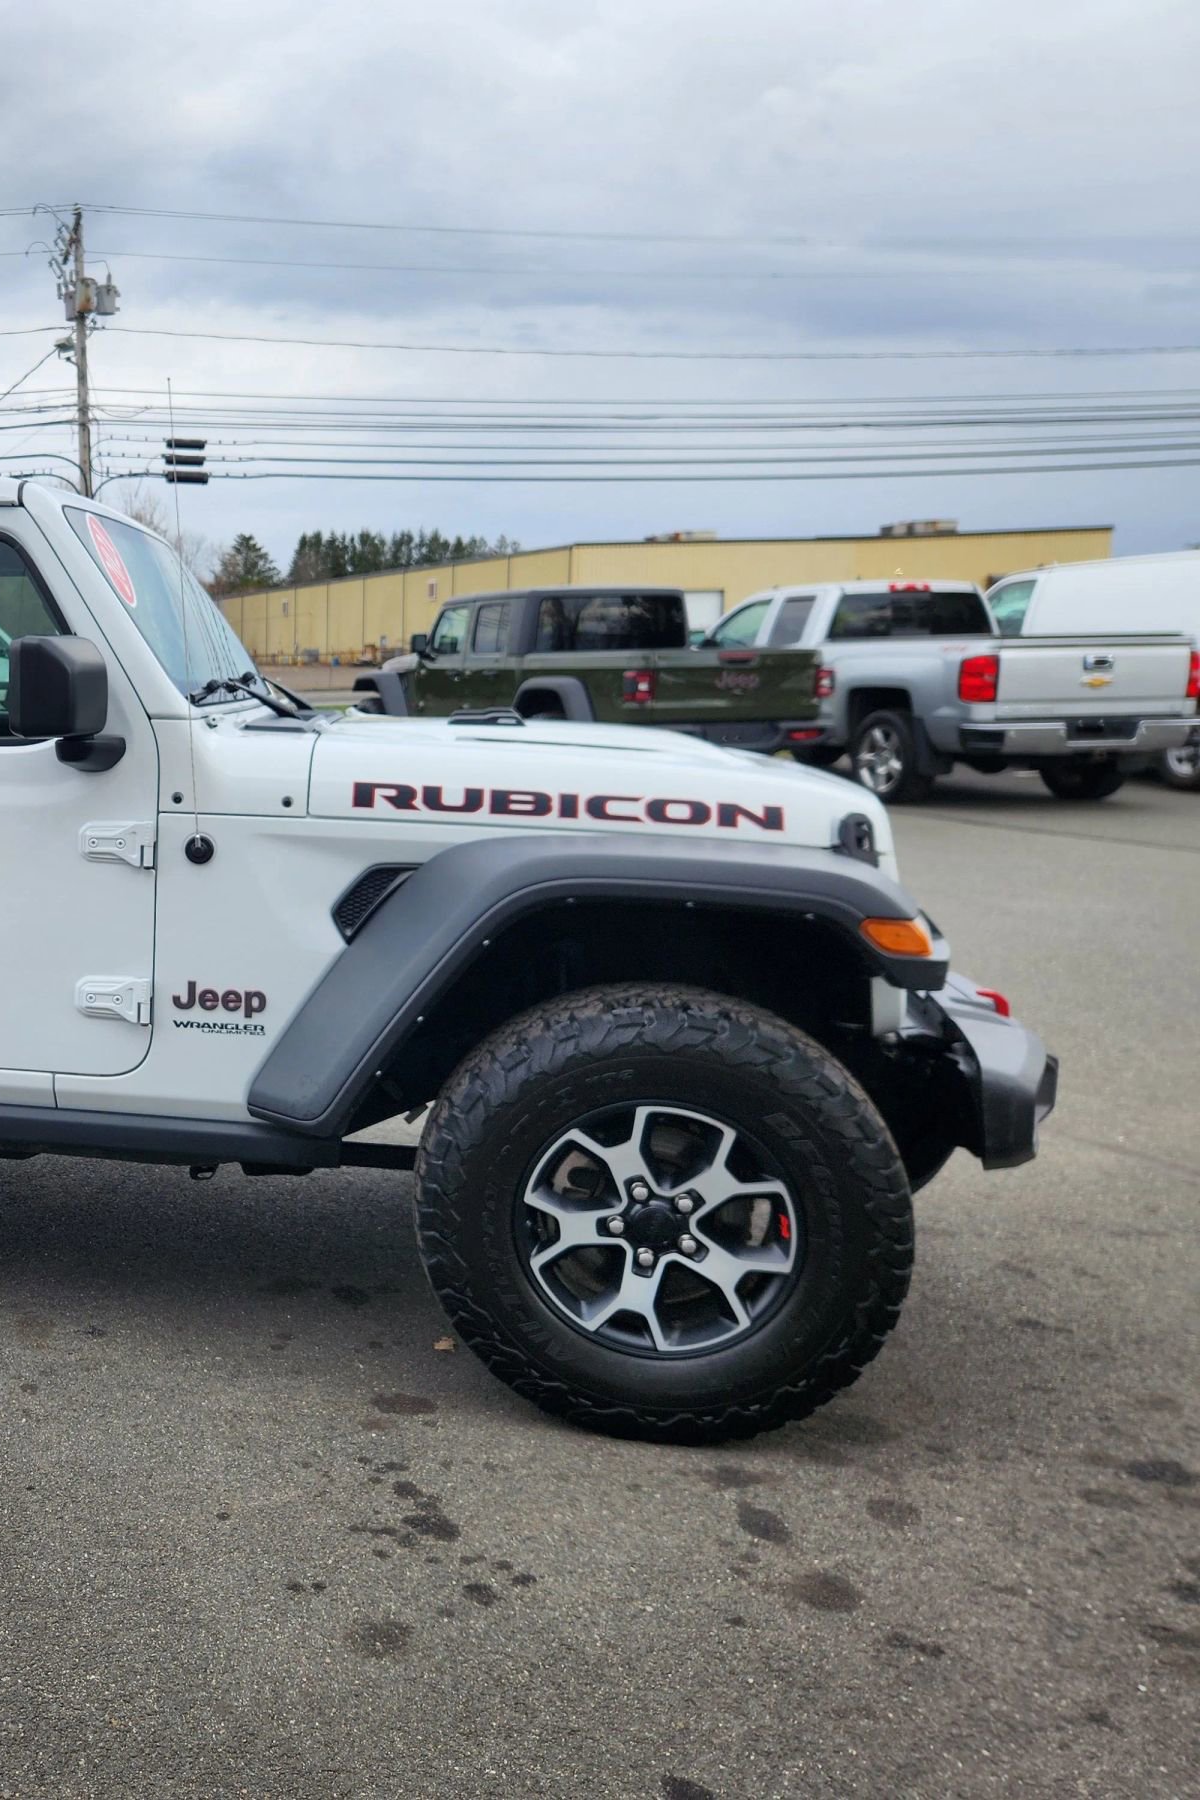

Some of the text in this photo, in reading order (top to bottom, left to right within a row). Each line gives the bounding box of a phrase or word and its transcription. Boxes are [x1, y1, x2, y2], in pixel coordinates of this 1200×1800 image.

[351, 781, 785, 831] RUBICON
[172, 980, 267, 1019] Jeep
[172, 1020, 265, 1032] WRANGLER
